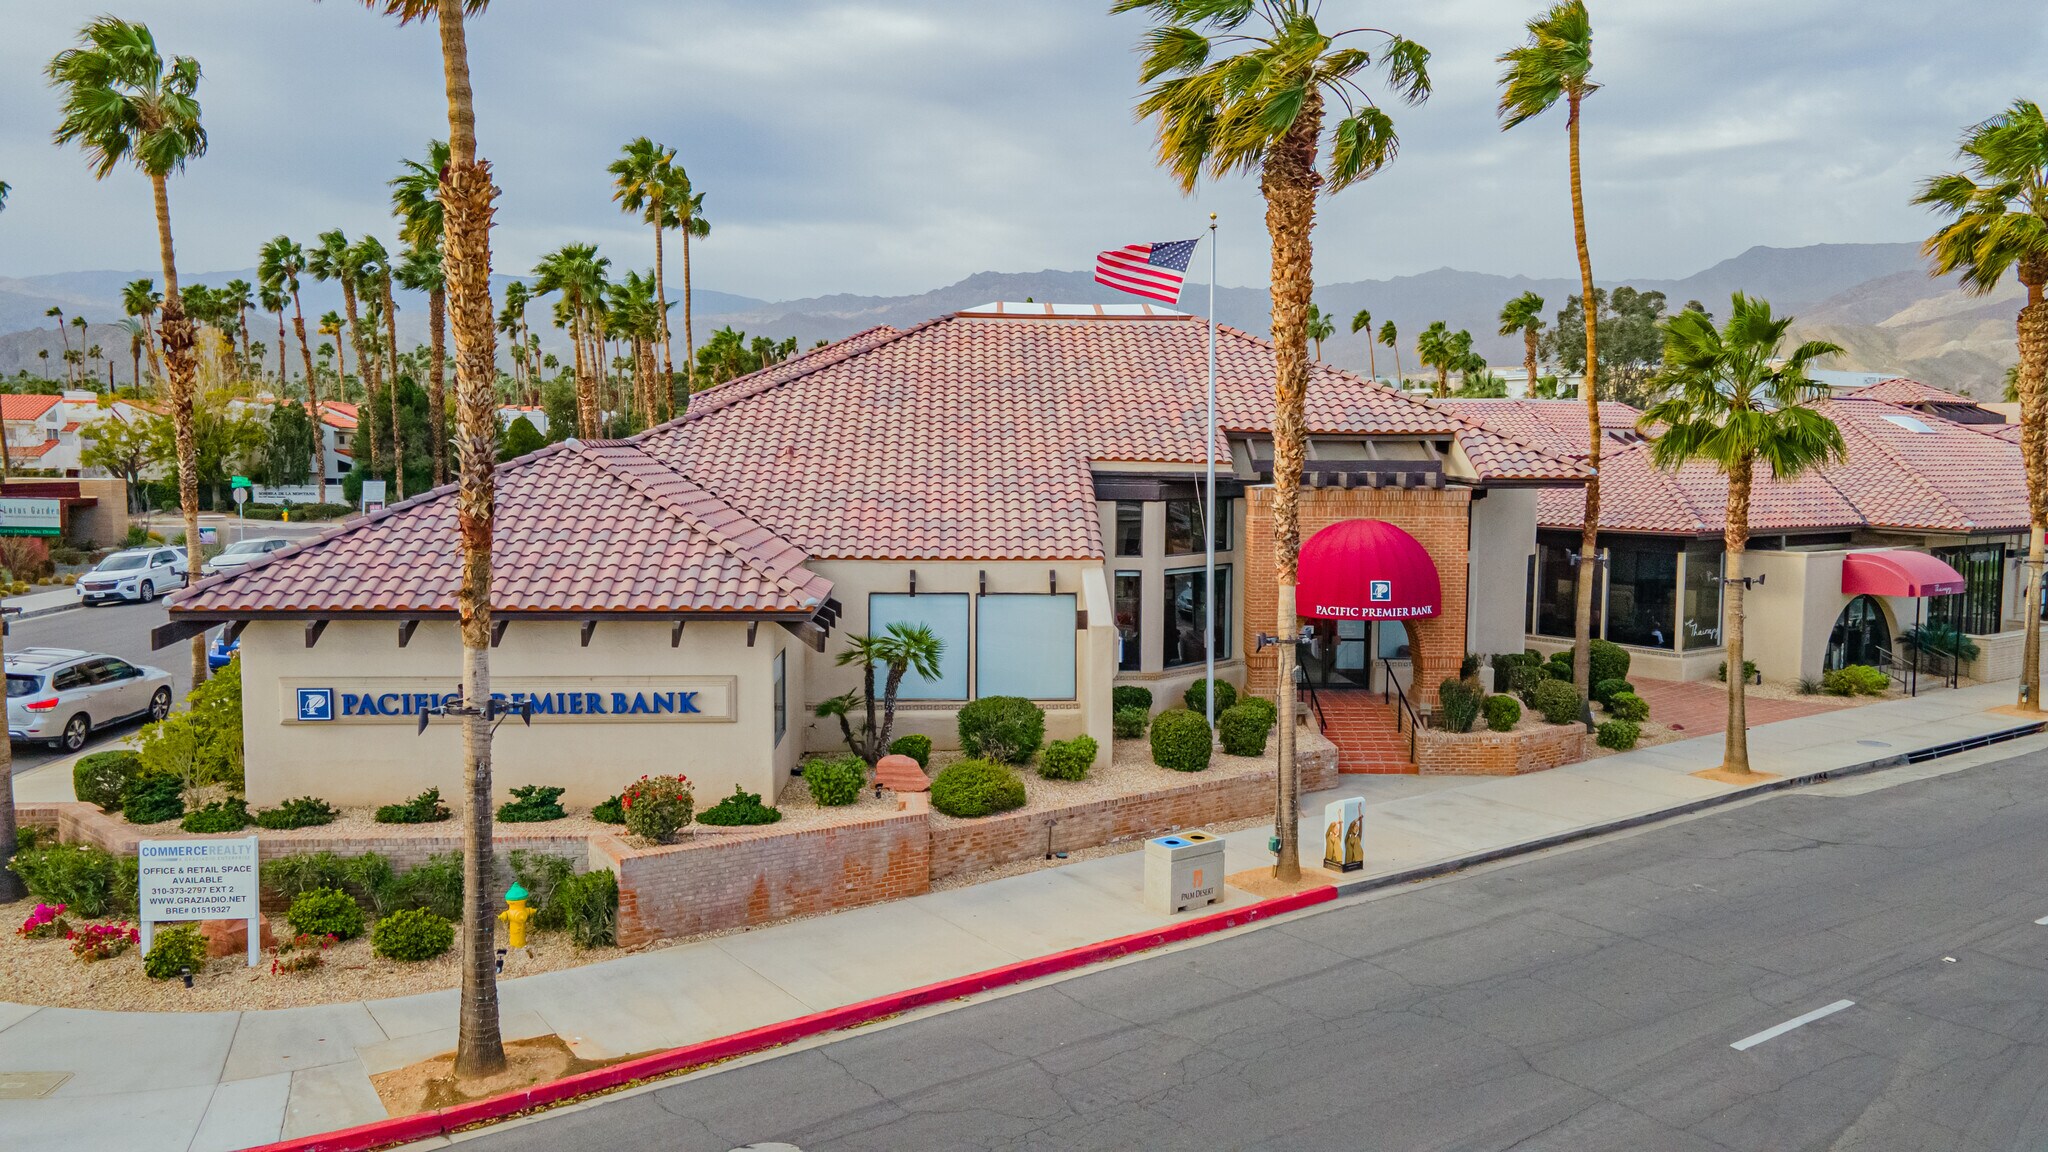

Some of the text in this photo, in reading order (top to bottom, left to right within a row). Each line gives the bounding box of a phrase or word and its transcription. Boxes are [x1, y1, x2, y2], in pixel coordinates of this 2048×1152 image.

[3, 505, 27, 514] Lotus
[1316, 605, 1433, 617] PACIFIC PREMIER BANK
[489, 692, 607, 715] REMIER
[611, 691, 701, 714] BANK
[143, 867, 175, 875] OFFICE
[187, 866, 219, 874] RETAIL
[221, 865, 252, 873] SPACE
[172, 876, 223, 884] AVAILABLE
[152, 887, 207, 895] 310-373-2797
[209, 886, 227, 894] EXT
[149, 896, 247, 904] WWW.GRAZIADIO.NET
[166, 906, 231, 915] BRE# 01519327
